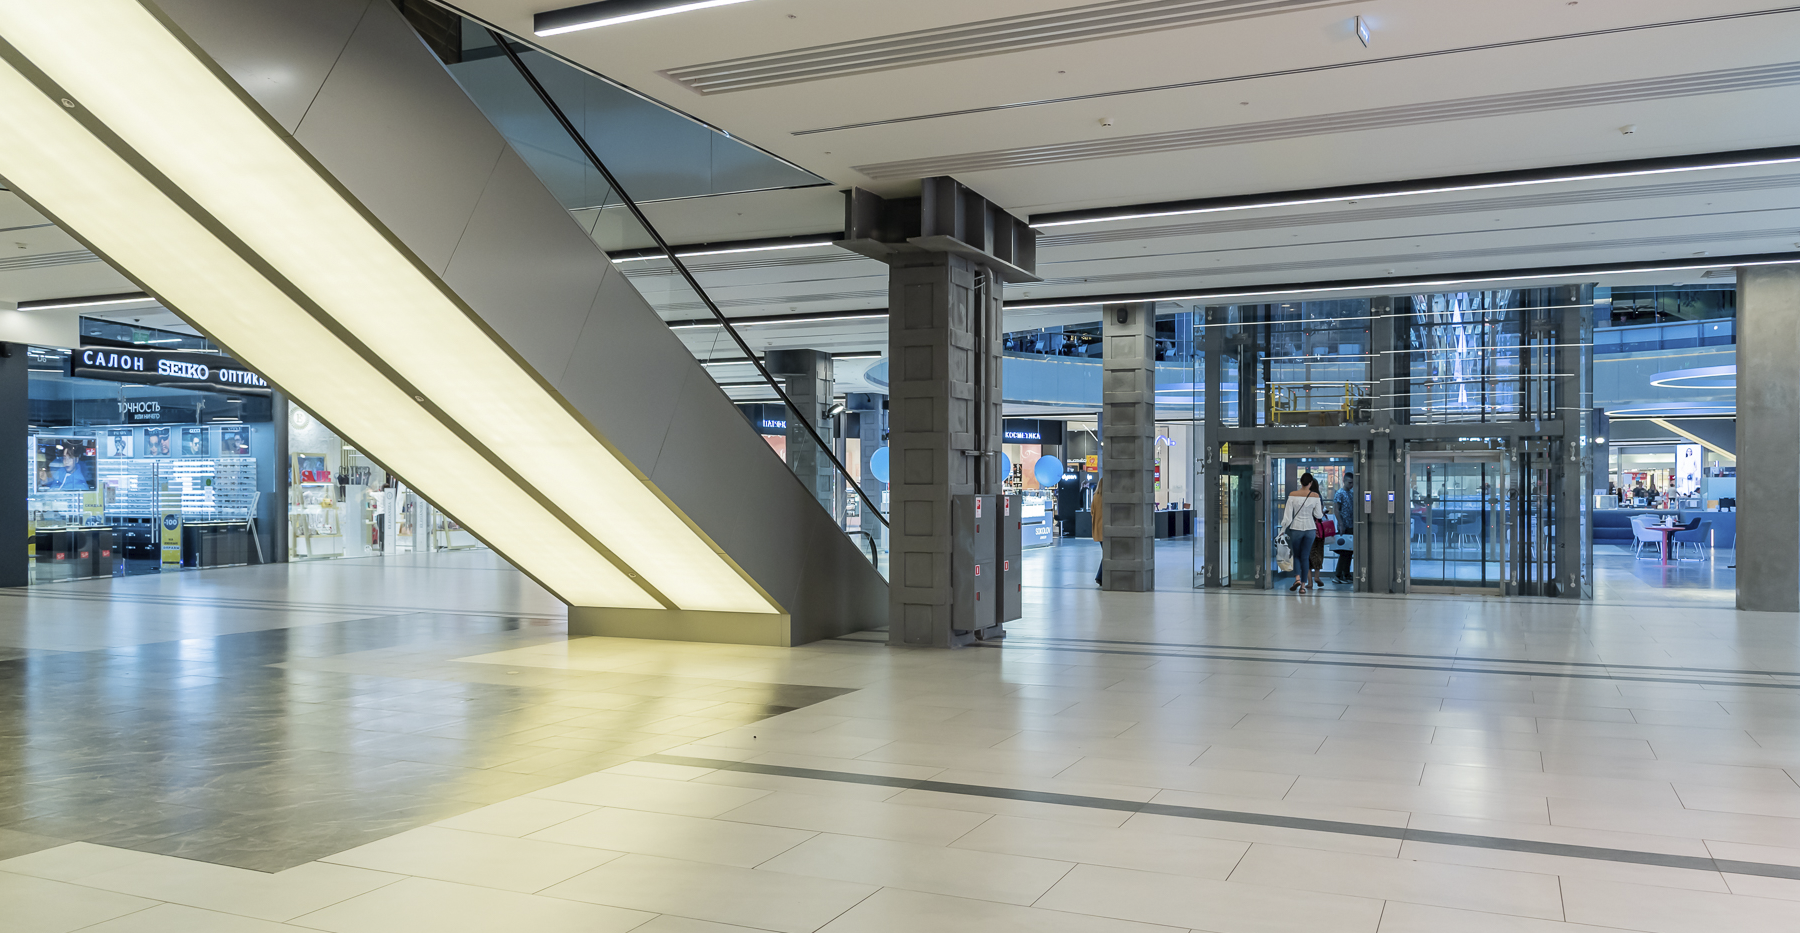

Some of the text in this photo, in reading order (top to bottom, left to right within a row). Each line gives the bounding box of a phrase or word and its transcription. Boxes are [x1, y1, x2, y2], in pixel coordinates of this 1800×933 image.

[83, 350, 144, 370] САЛОН
[158, 359, 209, 380] SEIKO
[117, 401, 161, 413] ТОЧНОСТЬ
[163, 518, 178, 526] -100
